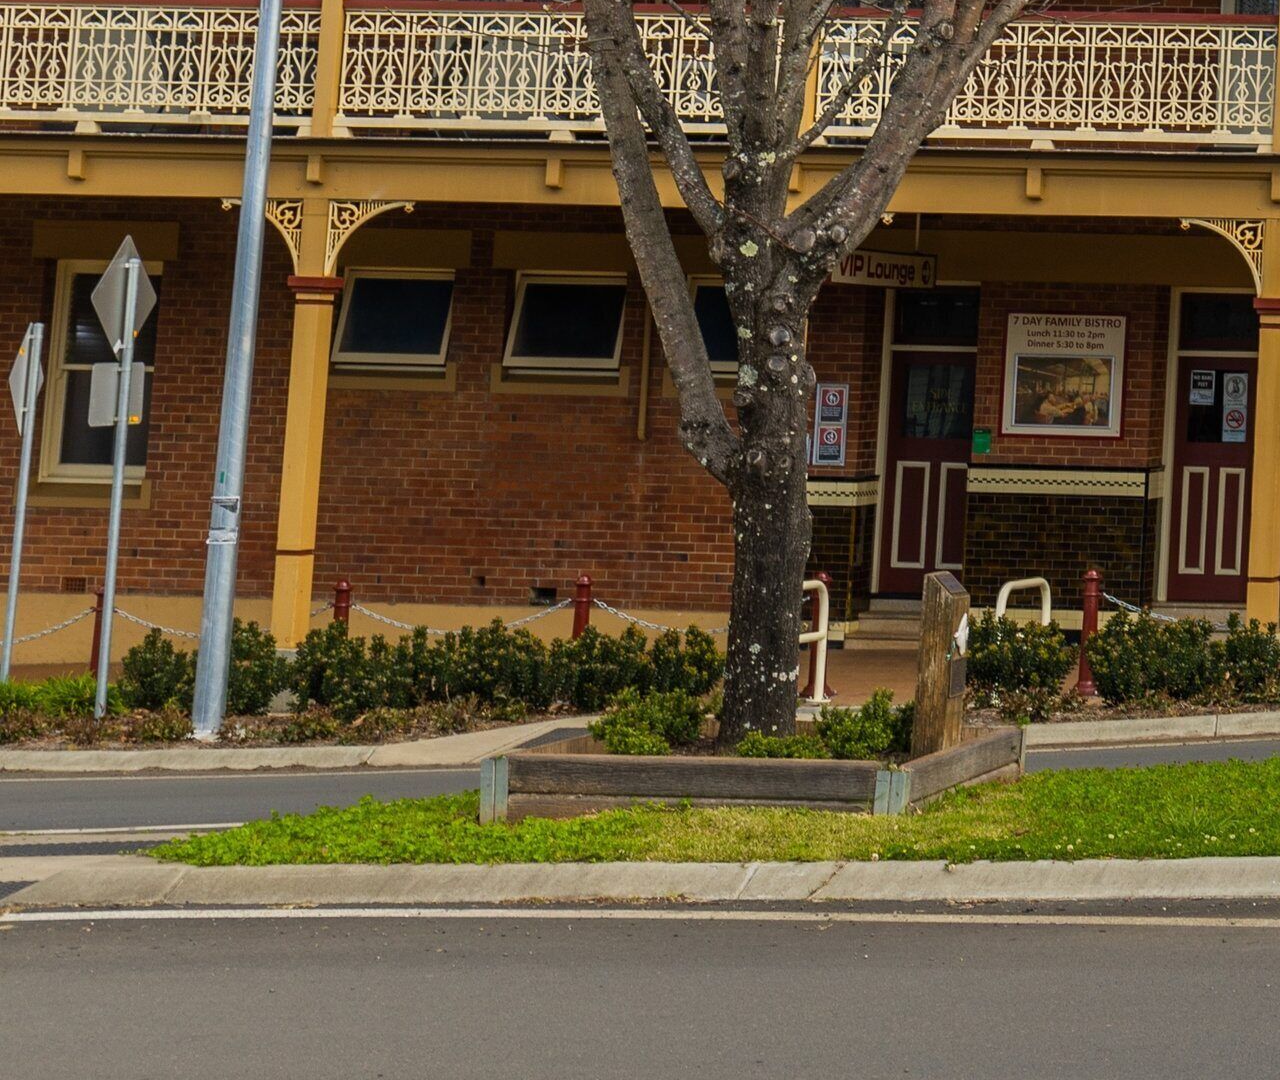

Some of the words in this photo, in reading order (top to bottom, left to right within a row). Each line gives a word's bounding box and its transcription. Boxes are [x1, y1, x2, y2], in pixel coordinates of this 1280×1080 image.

[840, 254, 864, 277] VIP
[867, 256, 916, 285] Lounge
[1013, 316, 1020, 325] 7
[1022, 317, 1042, 326] DAY
[1045, 317, 1082, 327] FAMILY
[1085, 319, 1122, 329] BISTRO
[1027, 329, 1051, 338] Lunch
[1053, 330, 1075, 339] 11:30
[1077, 331, 1086, 339] to
[1087, 331, 1106, 340] 2pm
[1027, 339, 1054, 348] Dinner
[1056, 340, 1074, 349] 5:30
[1075, 341, 1085, 349] to
[1086, 341, 1105, 350] 8pm
